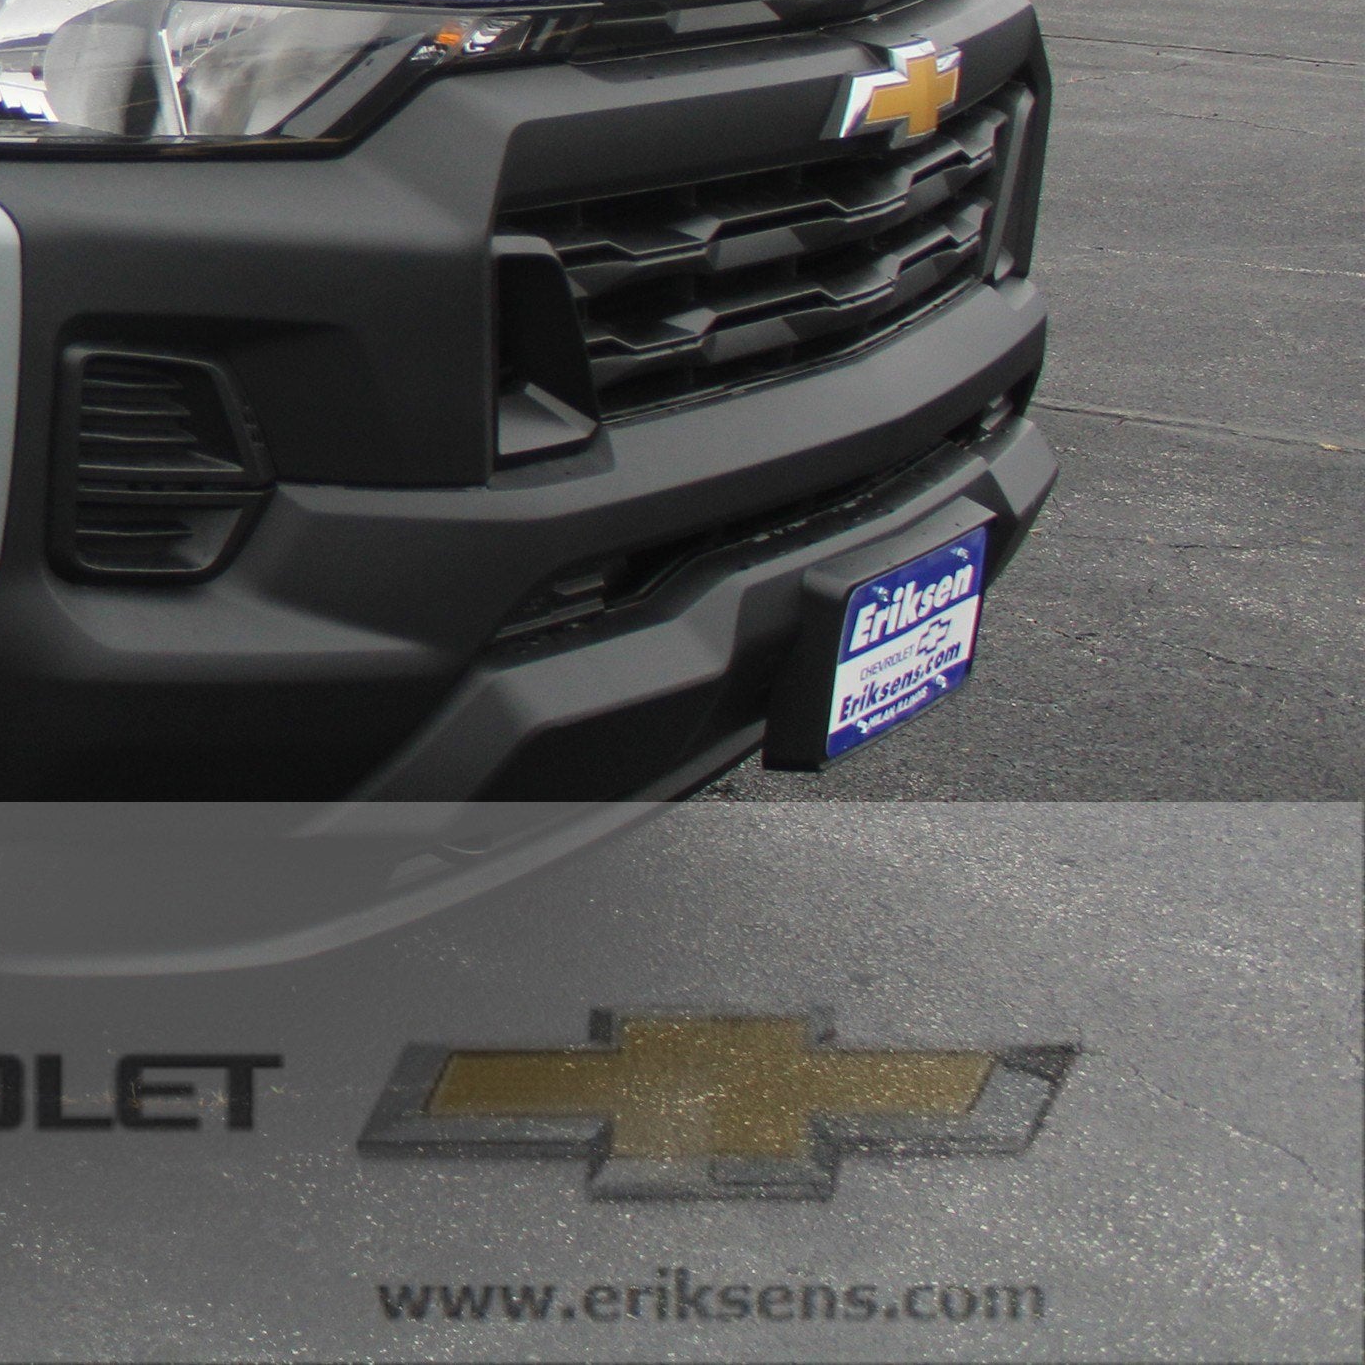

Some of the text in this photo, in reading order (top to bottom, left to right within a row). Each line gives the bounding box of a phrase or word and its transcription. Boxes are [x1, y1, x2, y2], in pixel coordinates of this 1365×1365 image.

[849, 564, 974, 653] Eriksen
[838, 641, 962, 723] Eriksens.com
[859, 643, 917, 682] CHEVROLET
